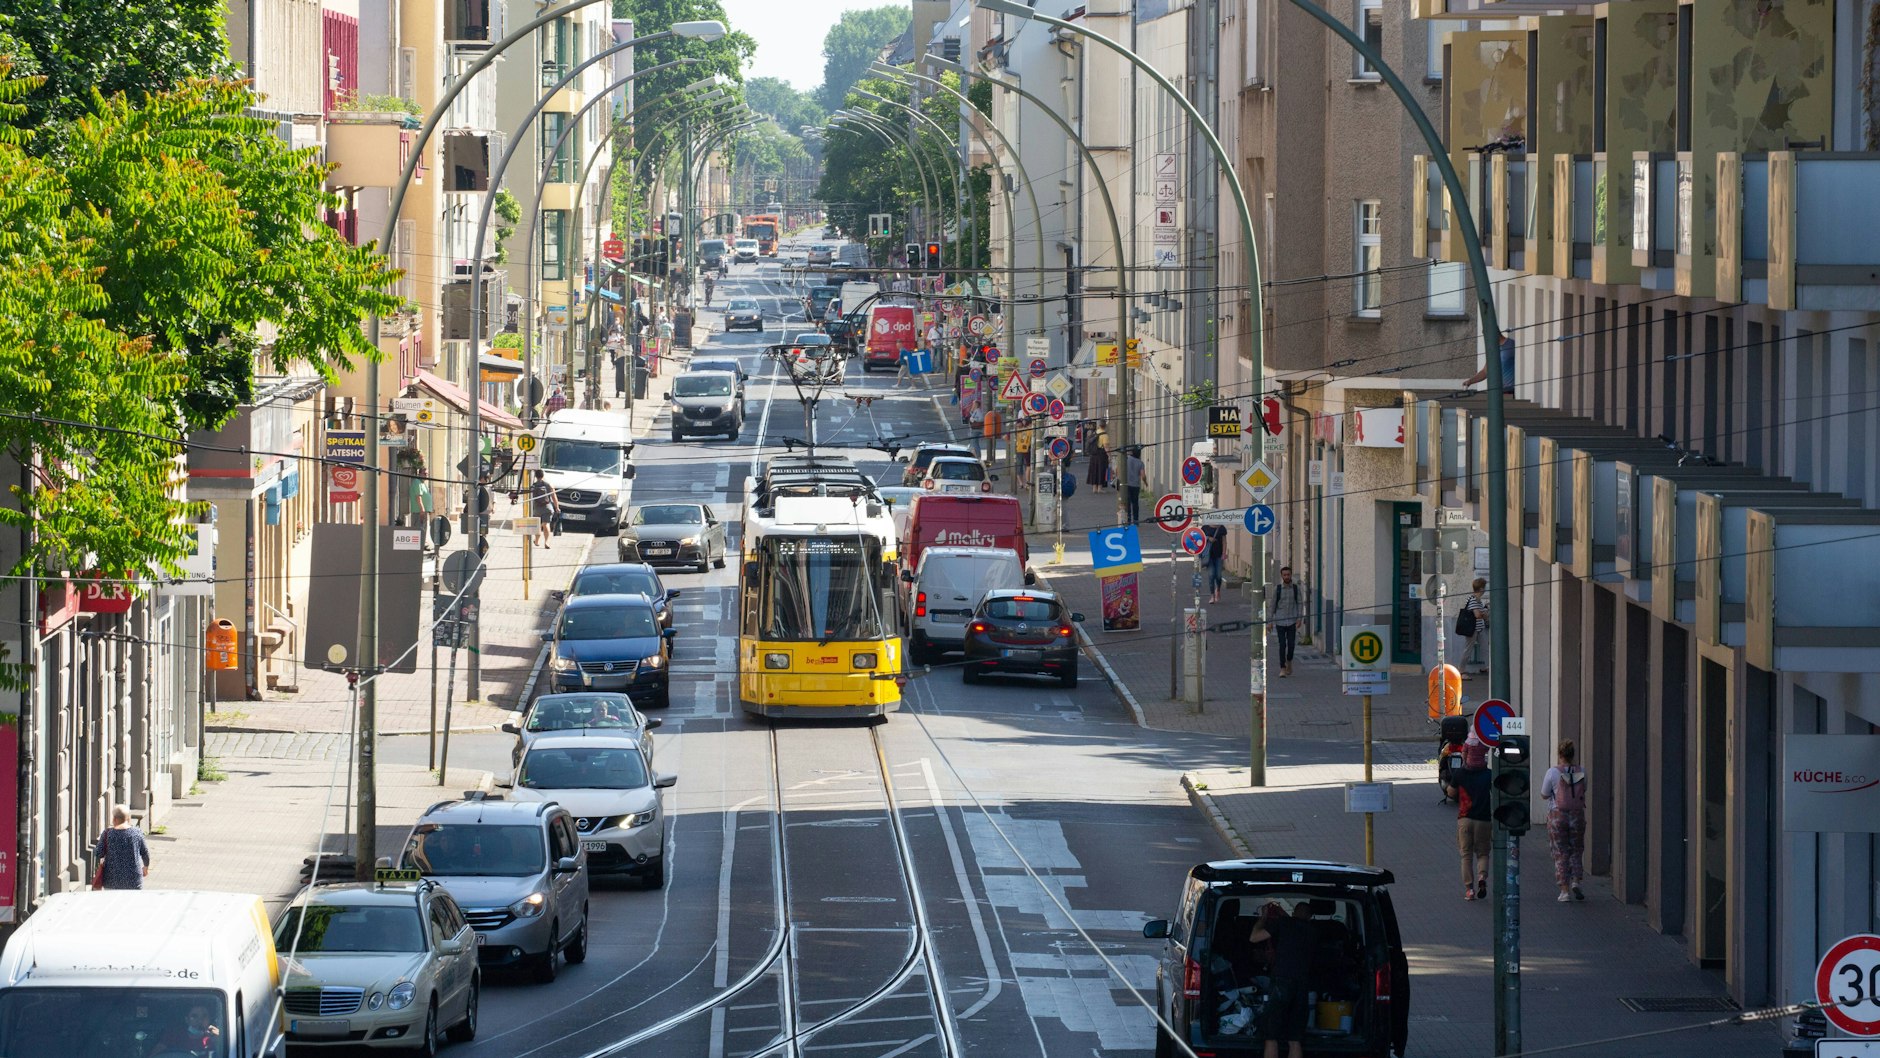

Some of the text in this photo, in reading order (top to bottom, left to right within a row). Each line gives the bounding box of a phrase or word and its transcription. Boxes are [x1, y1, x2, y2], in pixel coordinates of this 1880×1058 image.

[893, 321, 911, 333] dpd
[911, 351, 925, 372] T
[395, 400, 421, 409] Blumen
[1219, 409, 1241, 421] HA
[1212, 424, 1240, 433] STAT
[327, 438, 366, 446] SP@TKAU
[327, 449, 364, 457] LATESHO
[1206, 511, 1244, 521] Anna-Seghers
[395, 535, 411, 543] ABG
[948, 529, 995, 547] maltry
[1105, 533, 1127, 561] S
[87, 583, 126, 601] DR
[1506, 721, 1522, 730] 444
[1793, 768, 1843, 783] KÜCHE
[586, 841, 606, 851] 1996
[382, 868, 414, 879] TAXI
